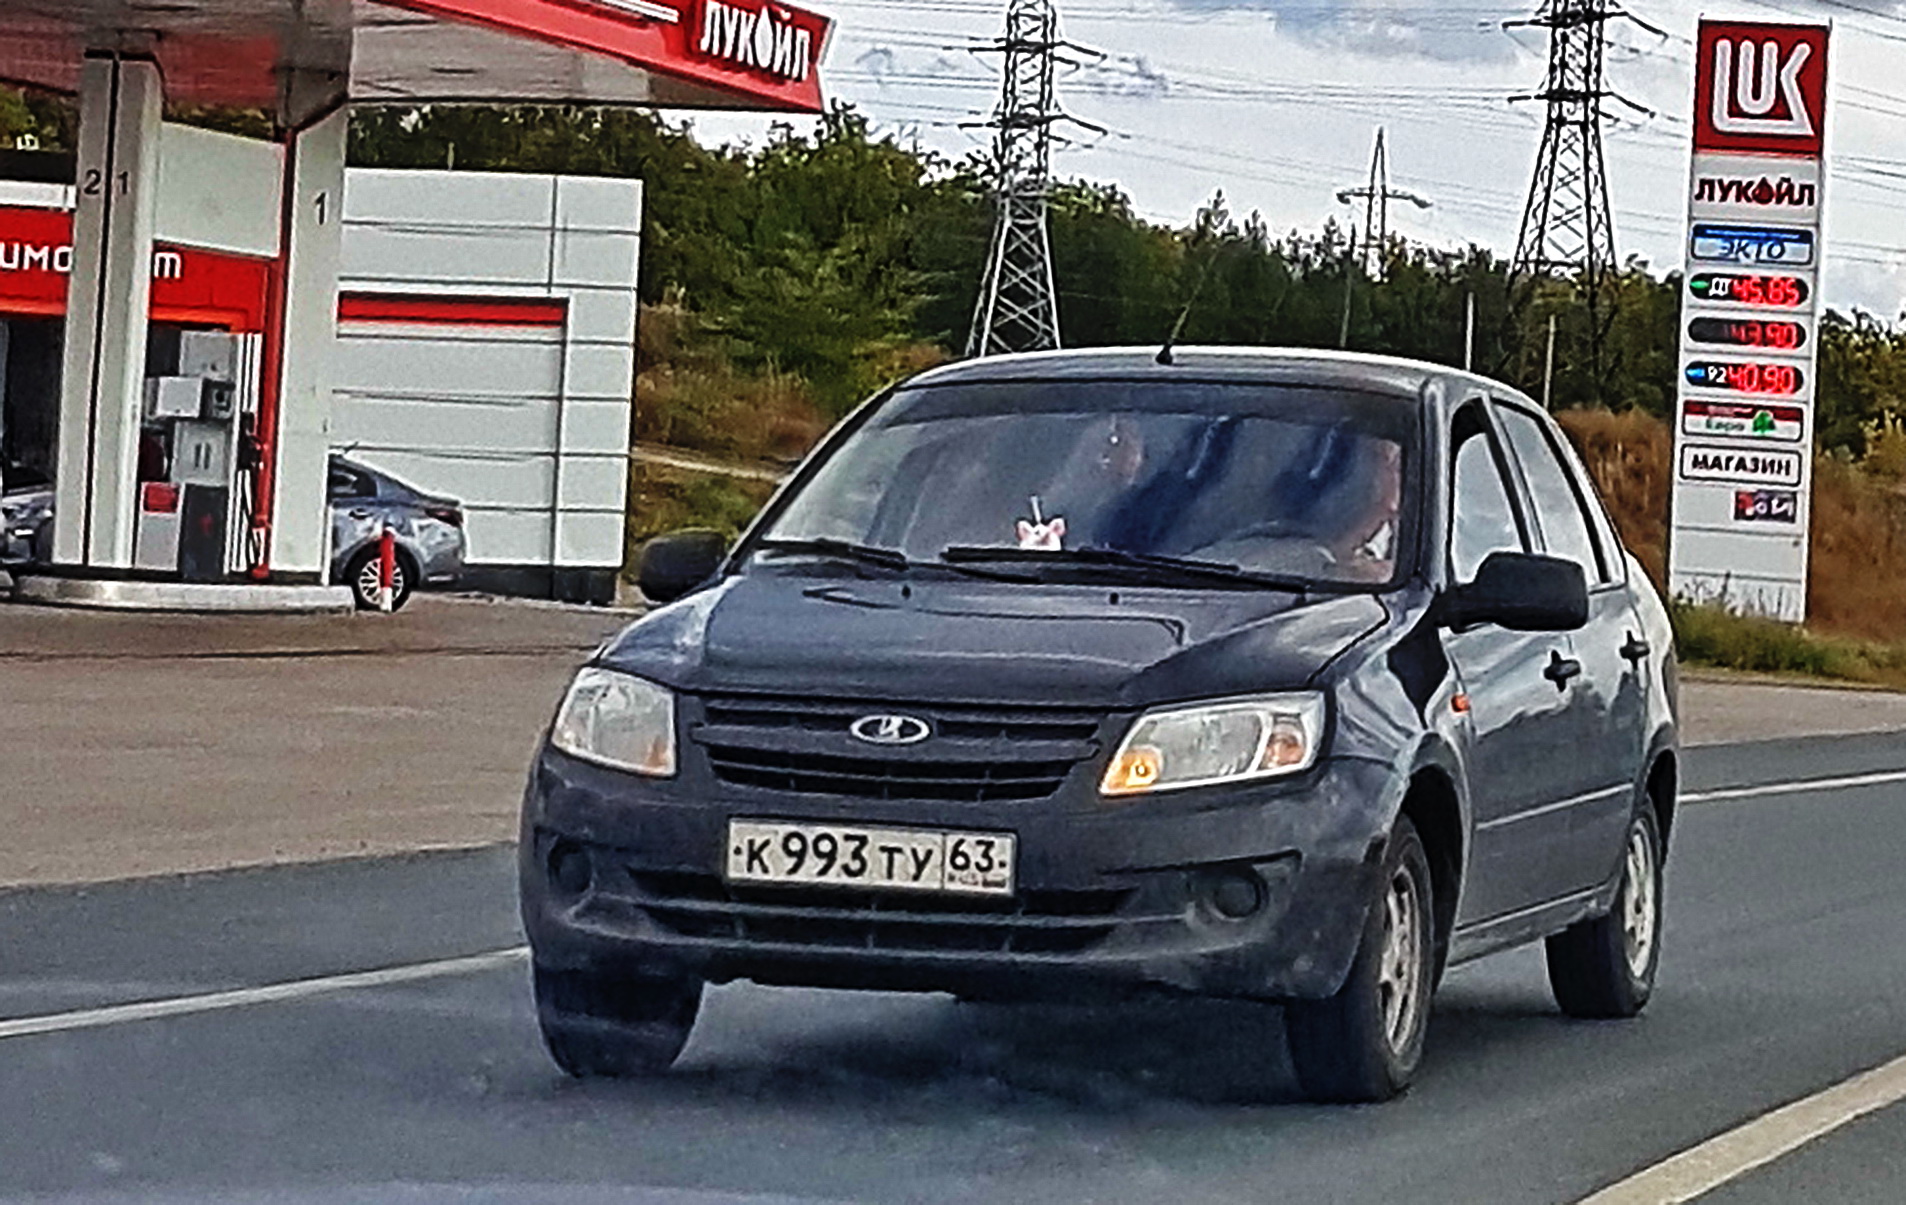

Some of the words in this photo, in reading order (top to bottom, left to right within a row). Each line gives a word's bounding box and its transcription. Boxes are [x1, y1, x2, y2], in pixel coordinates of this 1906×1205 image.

[83, 169, 101, 195] 2
[117, 171, 129, 195] 1
[314, 192, 327, 226] 1
[1692, 454, 1791, 476] МАГАЗИН
[949, 837, 995, 873] 63
